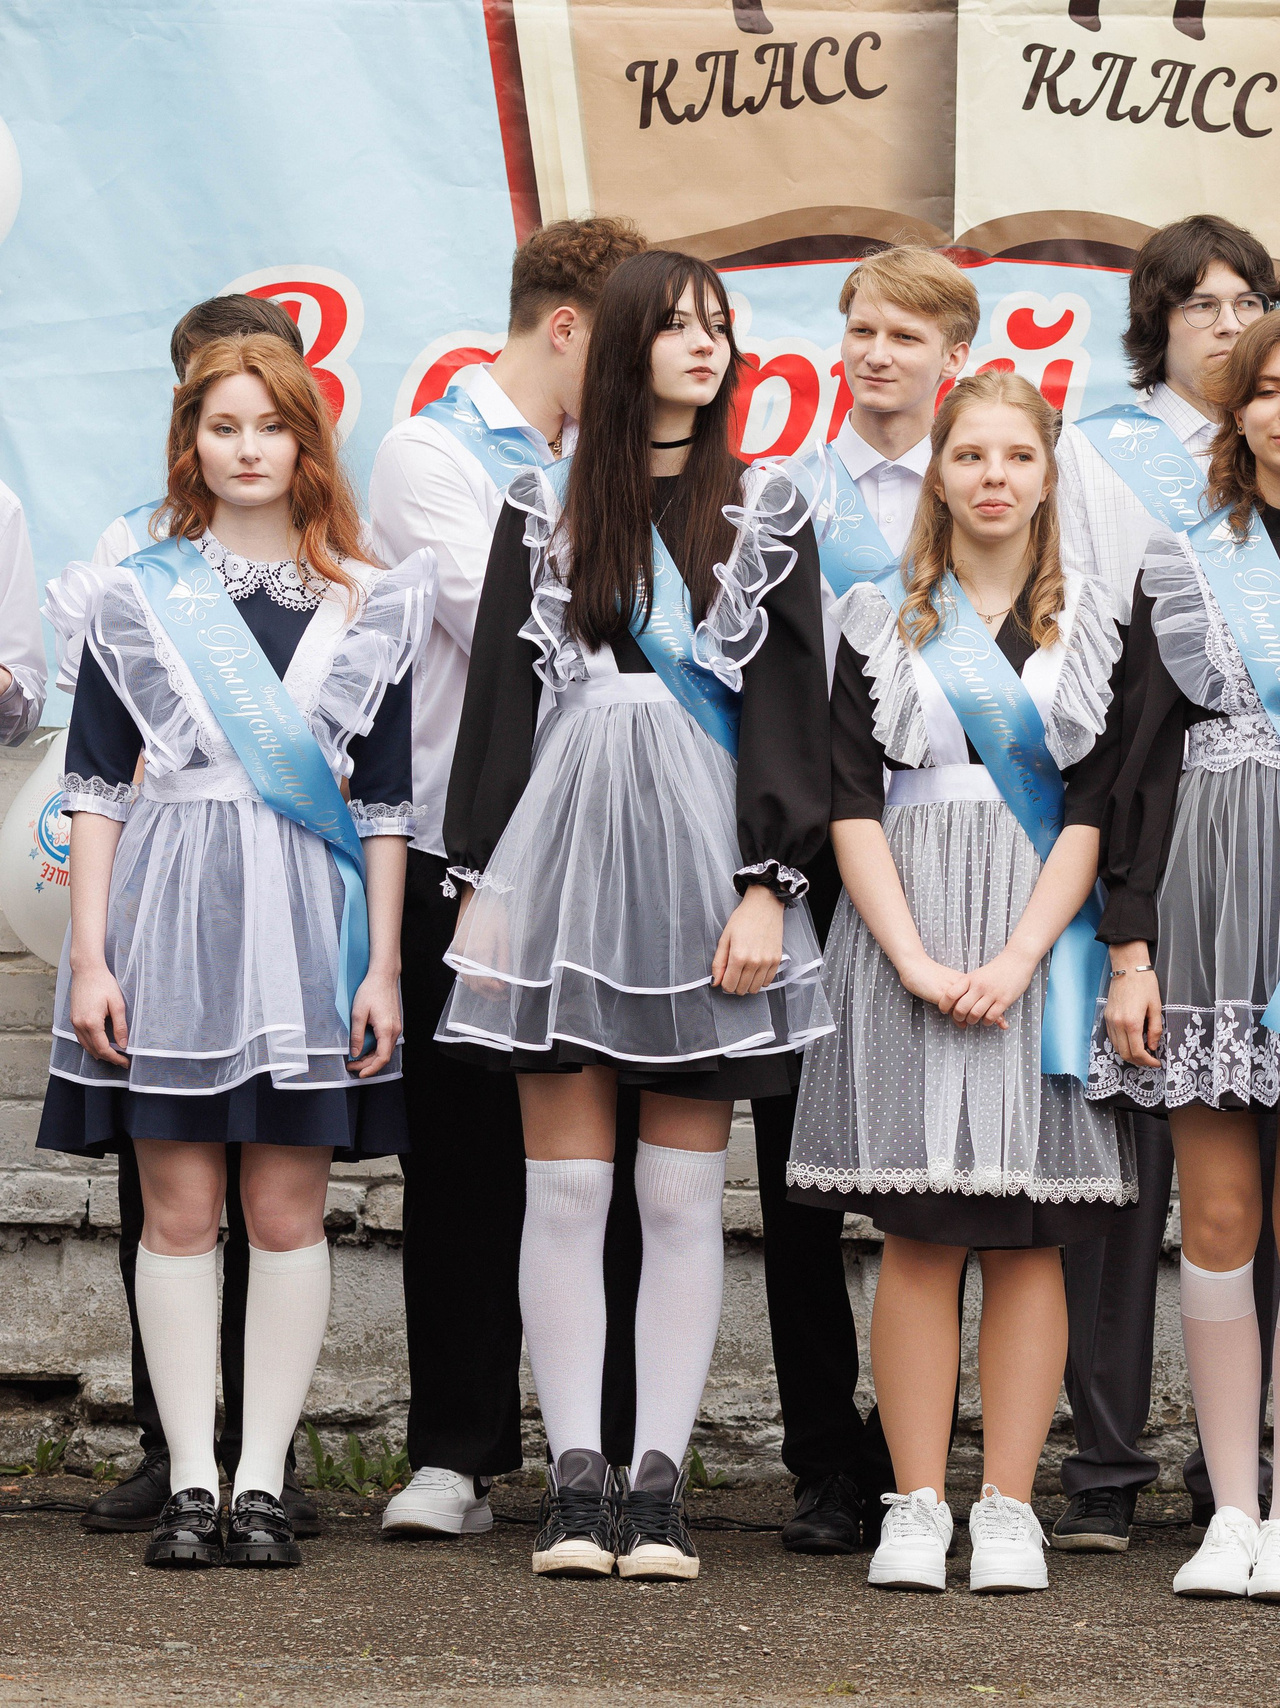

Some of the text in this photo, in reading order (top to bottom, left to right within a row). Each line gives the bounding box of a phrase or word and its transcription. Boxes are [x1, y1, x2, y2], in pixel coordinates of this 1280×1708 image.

[625, 31, 888, 129] КЛАСС
[1022, 43, 1278, 138] КЛАСС
[197, 624, 314, 810] Выпускница
[938, 626, 1042, 804] Выпускница
